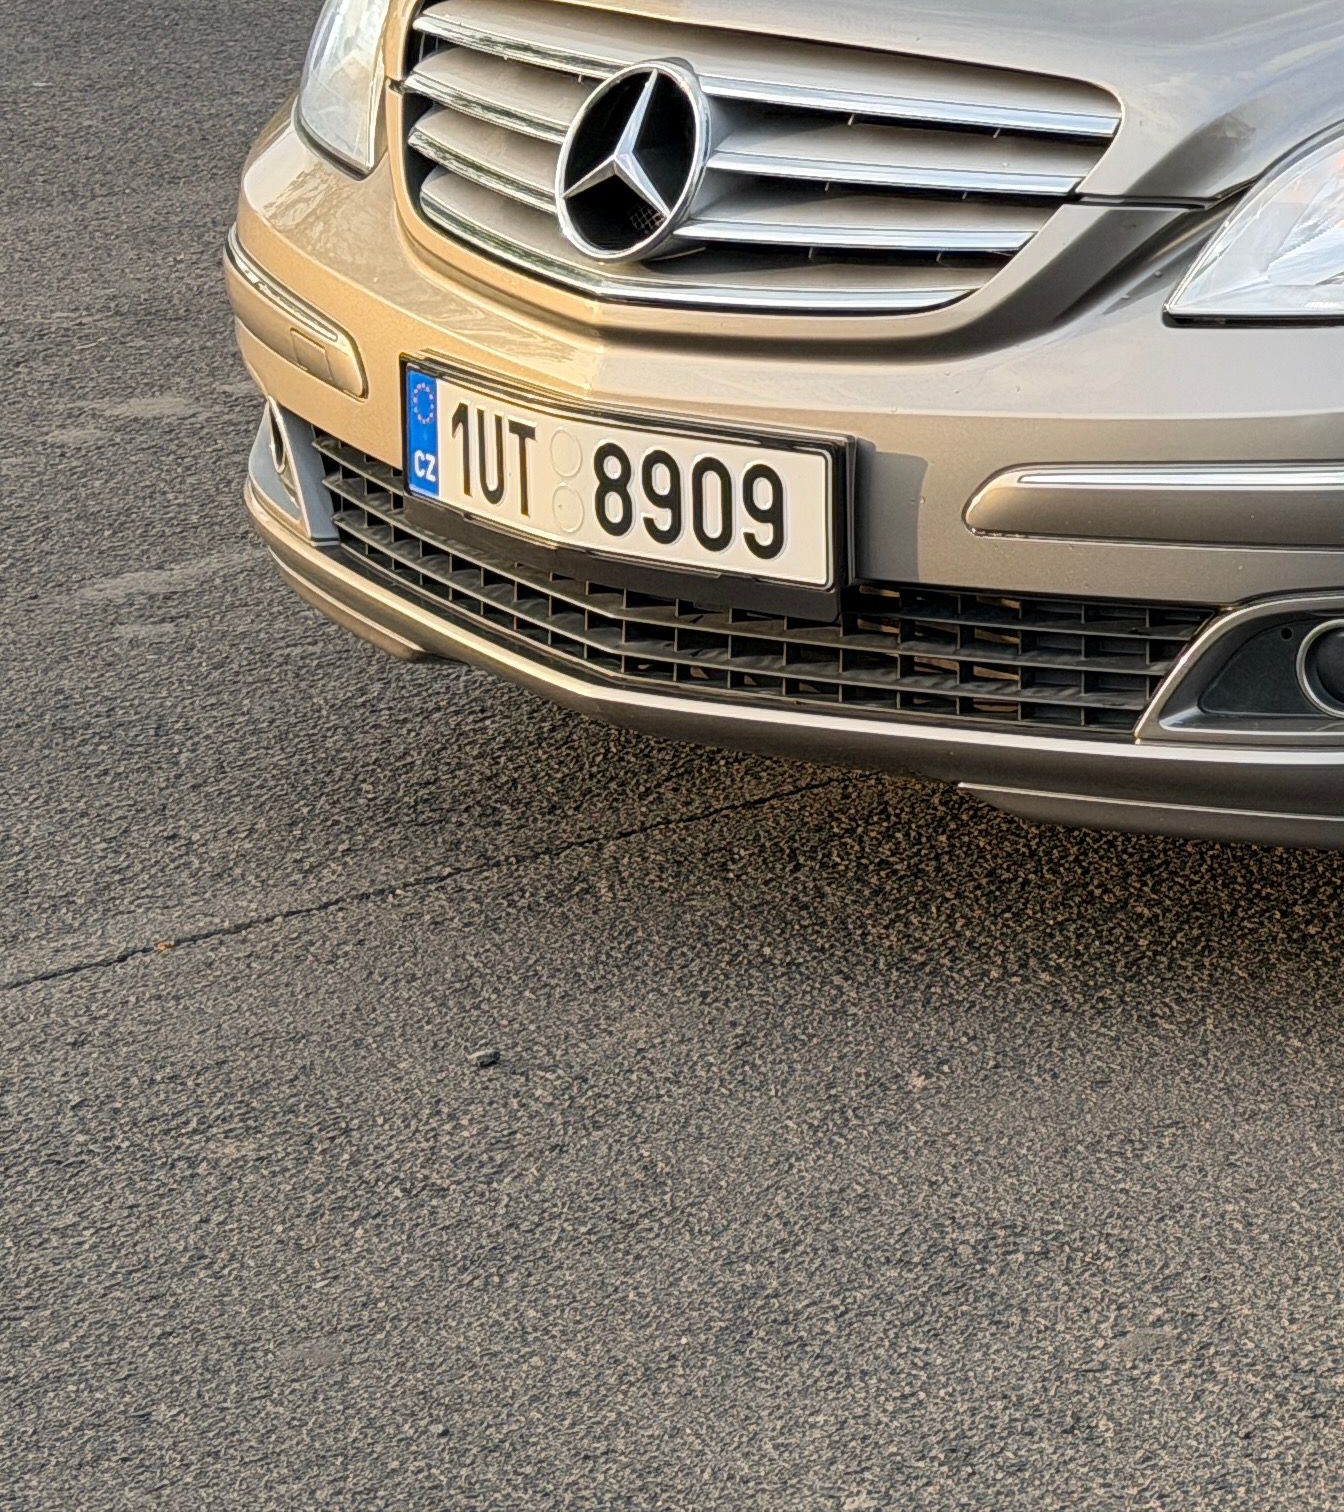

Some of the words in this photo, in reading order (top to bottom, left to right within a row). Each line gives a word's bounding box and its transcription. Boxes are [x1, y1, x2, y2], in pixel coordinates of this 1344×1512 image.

[414, 449, 437, 482] CZ
[451, 402, 536, 517] 1UT
[593, 442, 784, 560] 8909
